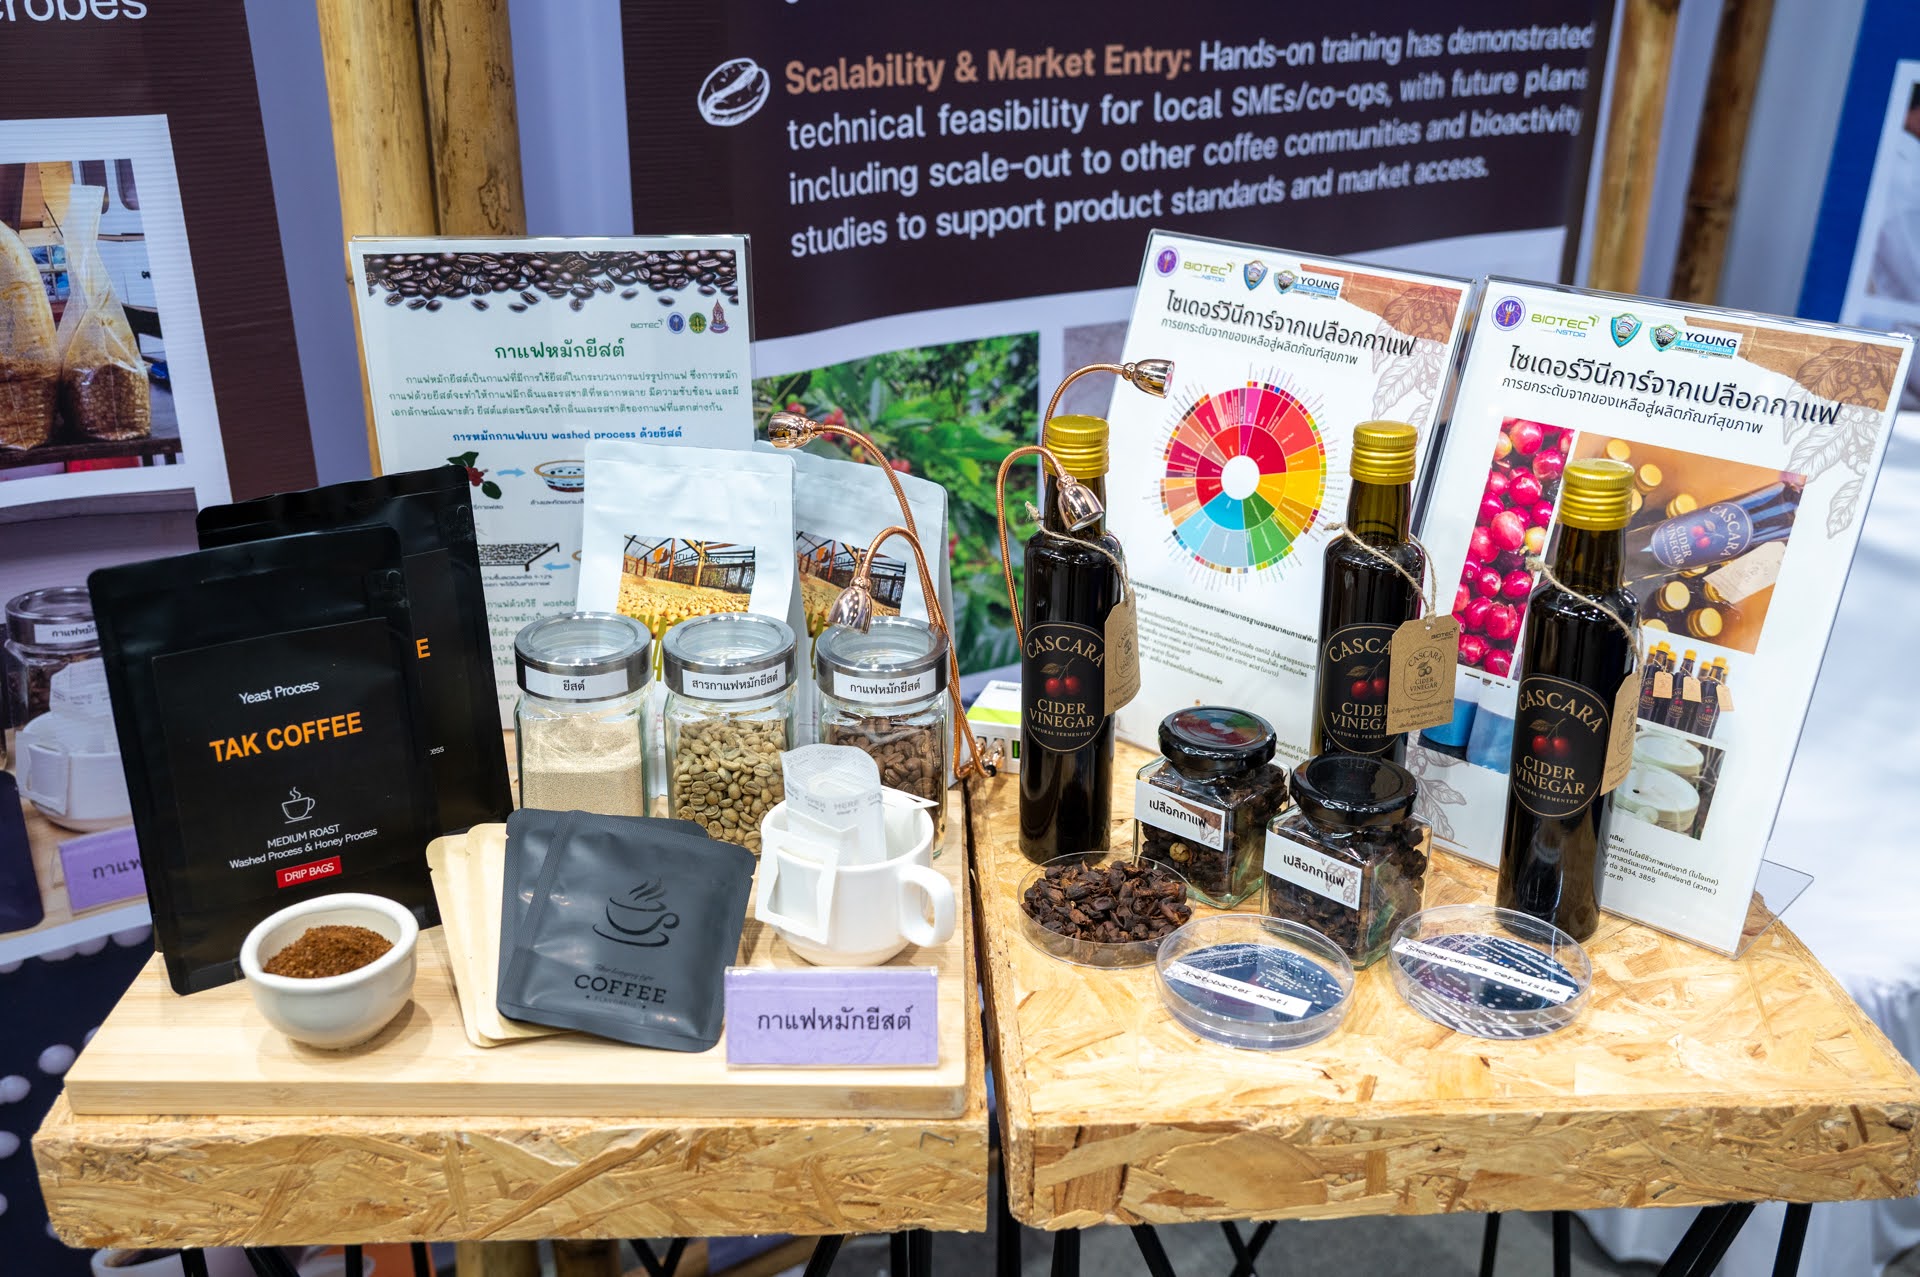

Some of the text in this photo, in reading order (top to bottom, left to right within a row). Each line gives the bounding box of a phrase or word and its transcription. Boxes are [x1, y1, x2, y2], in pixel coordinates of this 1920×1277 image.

[785, 21, 1594, 95] Scalability & Market Entry: Hands-on training has demonstrated
[787, 105, 925, 150] technical
[937, 96, 1090, 137] feasibility
[1101, 88, 1140, 126] for
[1153, 86, 1222, 122] local
[1231, 82, 1392, 117] SMEs/co-ops,
[1400, 70, 1445, 102] with
[1451, 65, 1518, 98] future
[789, 102, 1582, 204] including scale-out to other coffee communities and bioactivity
[790, 153, 1489, 259] studies to support product standards and market access.
[1183, 261, 1229, 276] BIOTEC
[1301, 276, 1340, 290] YOUNG
[630, 321, 661, 330] BIOTEC
[1166, 289, 1418, 357] ไซเดอร์วีนีการ์จากเปลือกกาแฟ
[1531, 313, 1589, 330] BIOTEC
[1161, 317, 1358, 366] การยกระดับจากของเหลือสู่ผลิตภัณฑ์สุขภาพ
[1556, 329, 1587, 338] NSTDA
[1685, 332, 1737, 348] YOUNG
[494, 338, 625, 360] กาแฟหมักยีสต์
[1681, 341, 1732, 354] ENTREPRENEUR
[1706, 351, 1733, 359] COMMERCE
[715, 385, 739, 397] และมี
[1509, 344, 1842, 426] ไซเดอร์วีนีการ์จากเปลือกกาแฟ
[1502, 376, 1763, 435] การยกระดับจากของเหลือสู่ผลิตภัณฑ์สุขภาพ
[453, 425, 682, 442] การหมักกาแฟแบบ washed process ด้วยยีสต์
[1676, 525, 1692, 557] CIDER
[1709, 504, 1741, 557] CASCARA
[1666, 523, 1685, 565] VINEGAR
[1431, 631, 1454, 640] BIOTEC
[1026, 635, 1104, 668] CASCARA
[1408, 650, 1443, 667] CASCARA
[563, 679, 585, 691] ยีสต์
[692, 671, 778, 691] สารกาแฟหมักยีสต์
[850, 677, 921, 694] กาแฟหมักยีสต์
[1409, 682, 1438, 692] VINEGAR
[1414, 677, 1434, 685] CIDER
[239, 681, 320, 704] Yeast Process
[1029, 707, 1095, 729] VINEGAR
[1037, 699, 1086, 715] CIDER
[1520, 689, 1603, 734] CASCARA
[209, 711, 363, 762] TAK COFFEE
[1031, 724, 1054, 736] NATURAL
[1333, 729, 1359, 739] NATURAL
[1523, 755, 1576, 780] CIDER
[1516, 763, 1585, 795] VINEGAR
[1540, 791, 1579, 804] FERMENTED
[1149, 797, 1207, 829] เปลือกกาแฟ
[267, 823, 340, 848] MEDIUM ROAST
[229, 828, 378, 869] Washed Process & Honey Process
[284, 862, 335, 882] DRIP BAGS
[1282, 852, 1346, 890] เปลือกกาแฟ
[1619, 865, 1637, 878] 3834,
[1638, 872, 1656, 883] 3855
[1405, 944, 1560, 995] Saccharomyces cerevisiae
[575, 974, 667, 1004] COFFEE
[1182, 970, 1289, 1006] Acetobacter aceti
[757, 1005, 914, 1031] กาแฟหมักยีสต์
